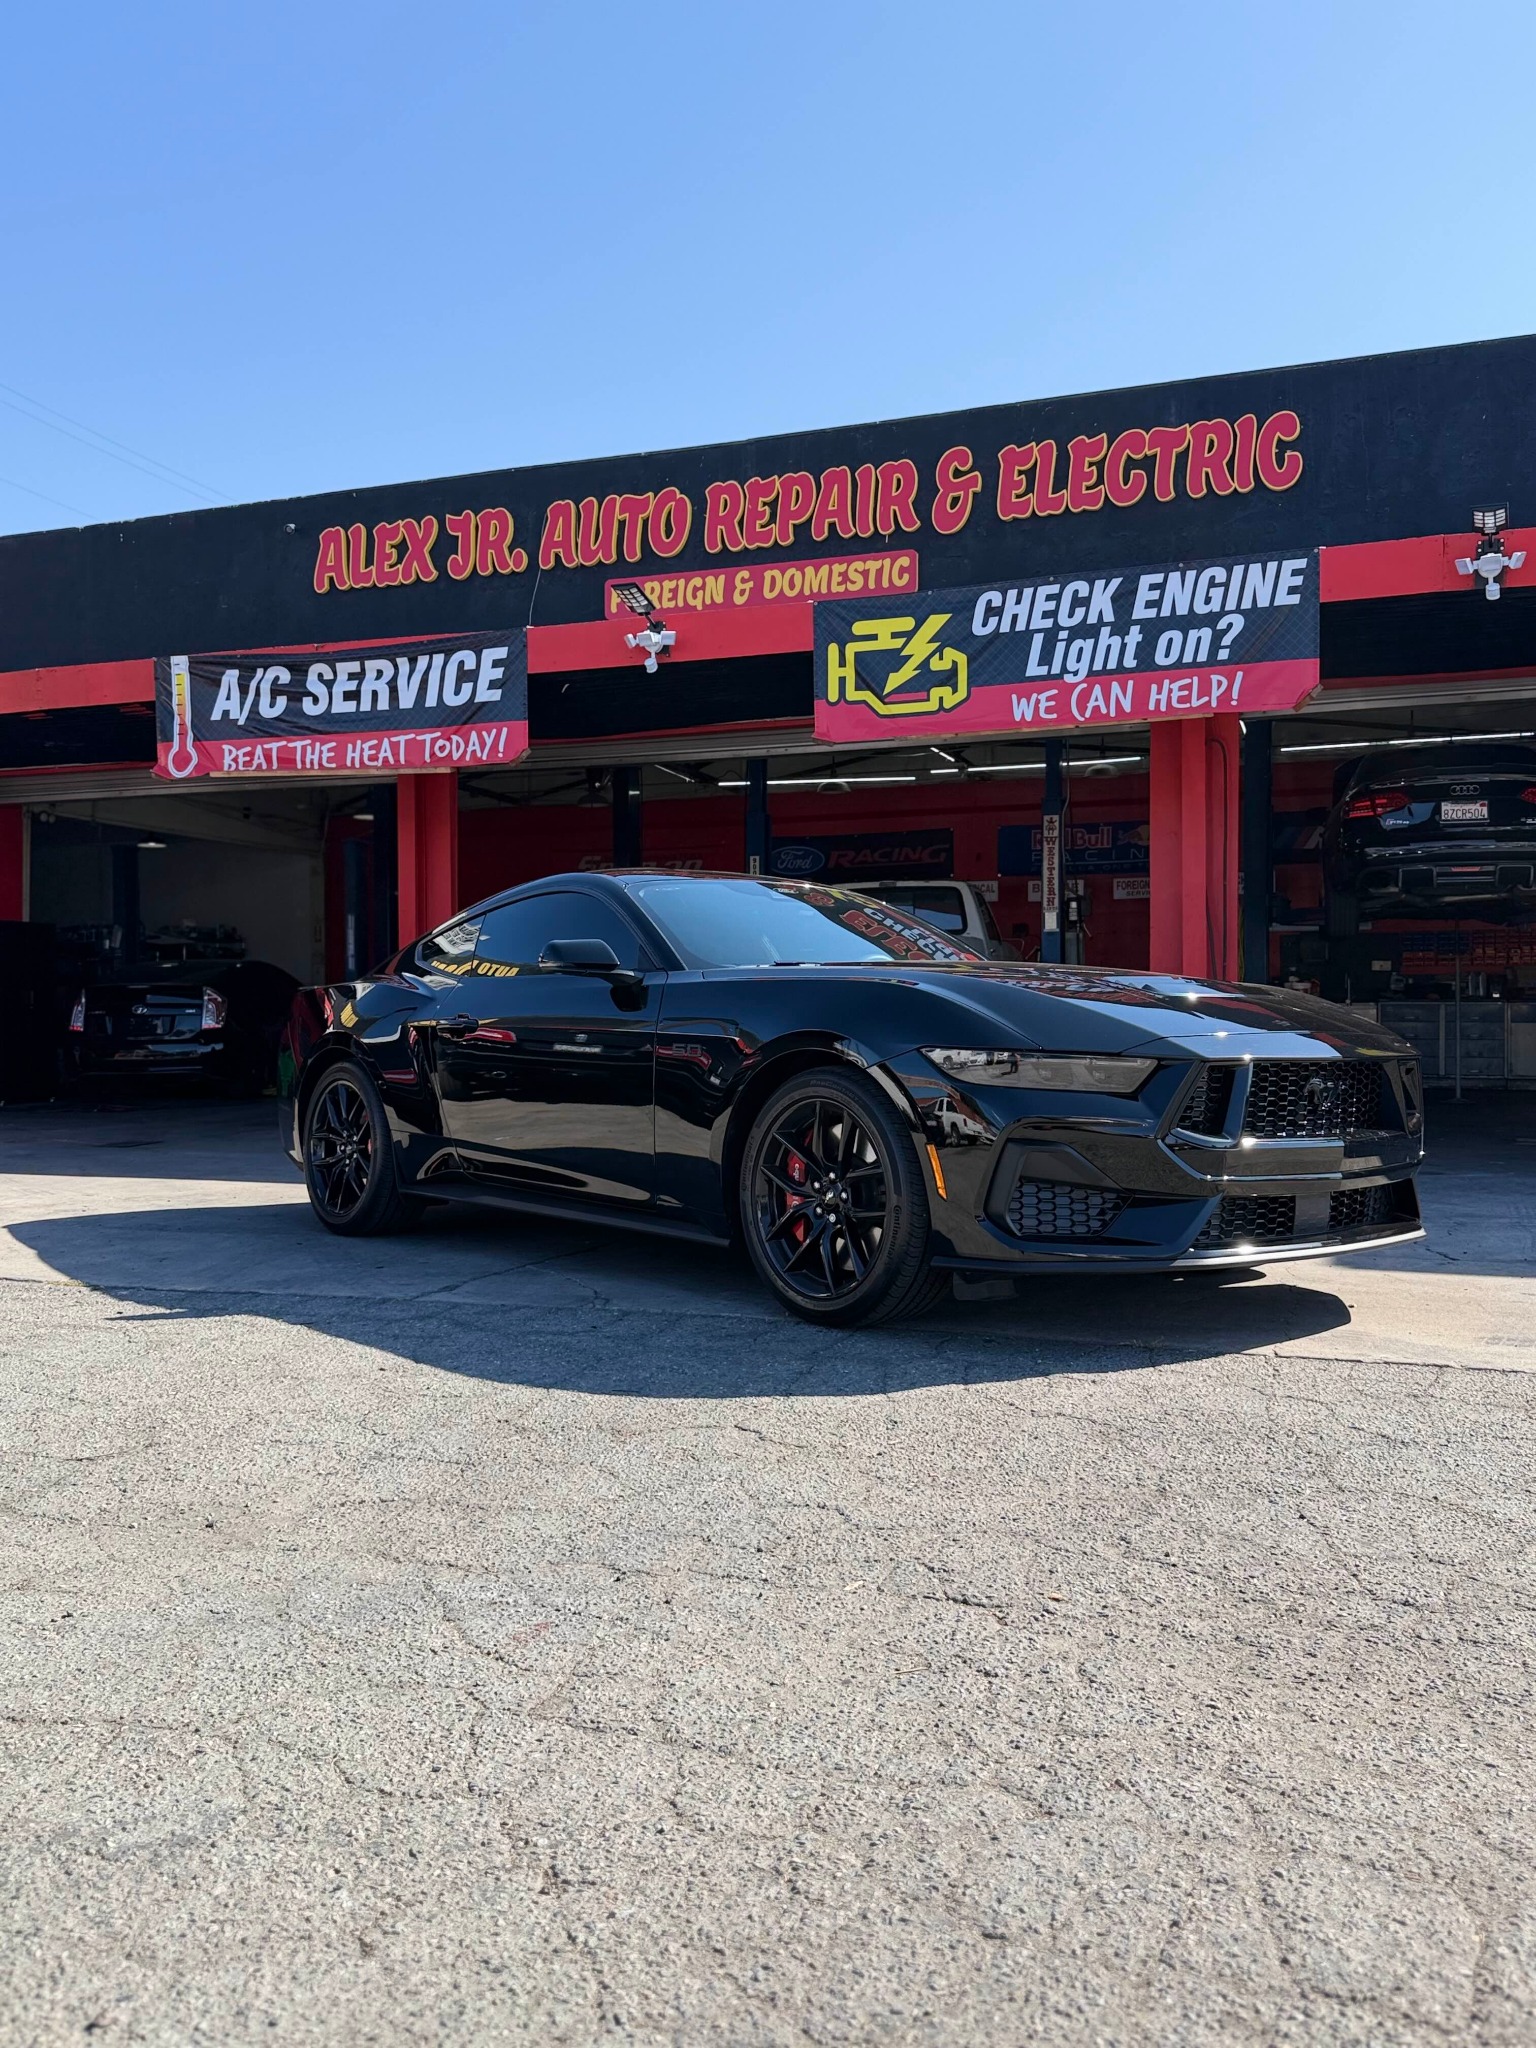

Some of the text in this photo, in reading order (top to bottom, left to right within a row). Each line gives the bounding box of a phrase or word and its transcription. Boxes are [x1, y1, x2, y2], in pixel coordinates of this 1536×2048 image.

[314, 410, 1304, 593] ALEX JR. AUTO REPAIR & ELECTRIC
[610, 556, 911, 613] FREIGN & DOMESTIC
[972, 558, 1308, 637] CHECK ENGINE
[1025, 614, 1245, 684] Light on?
[210, 647, 509, 726] A/C SERVICE
[1011, 671, 1244, 722] WE CAN HELP!
[222, 741, 287, 772] BEAT
[287, 739, 337, 769] THE
[346, 733, 415, 768] HEAT
[1072, 826, 1112, 849] Bull
[1443, 808, 1486, 819] 8ZCR504
[777, 843, 951, 870] Ford RACING
[1044, 836, 1057, 906] WESTERN
